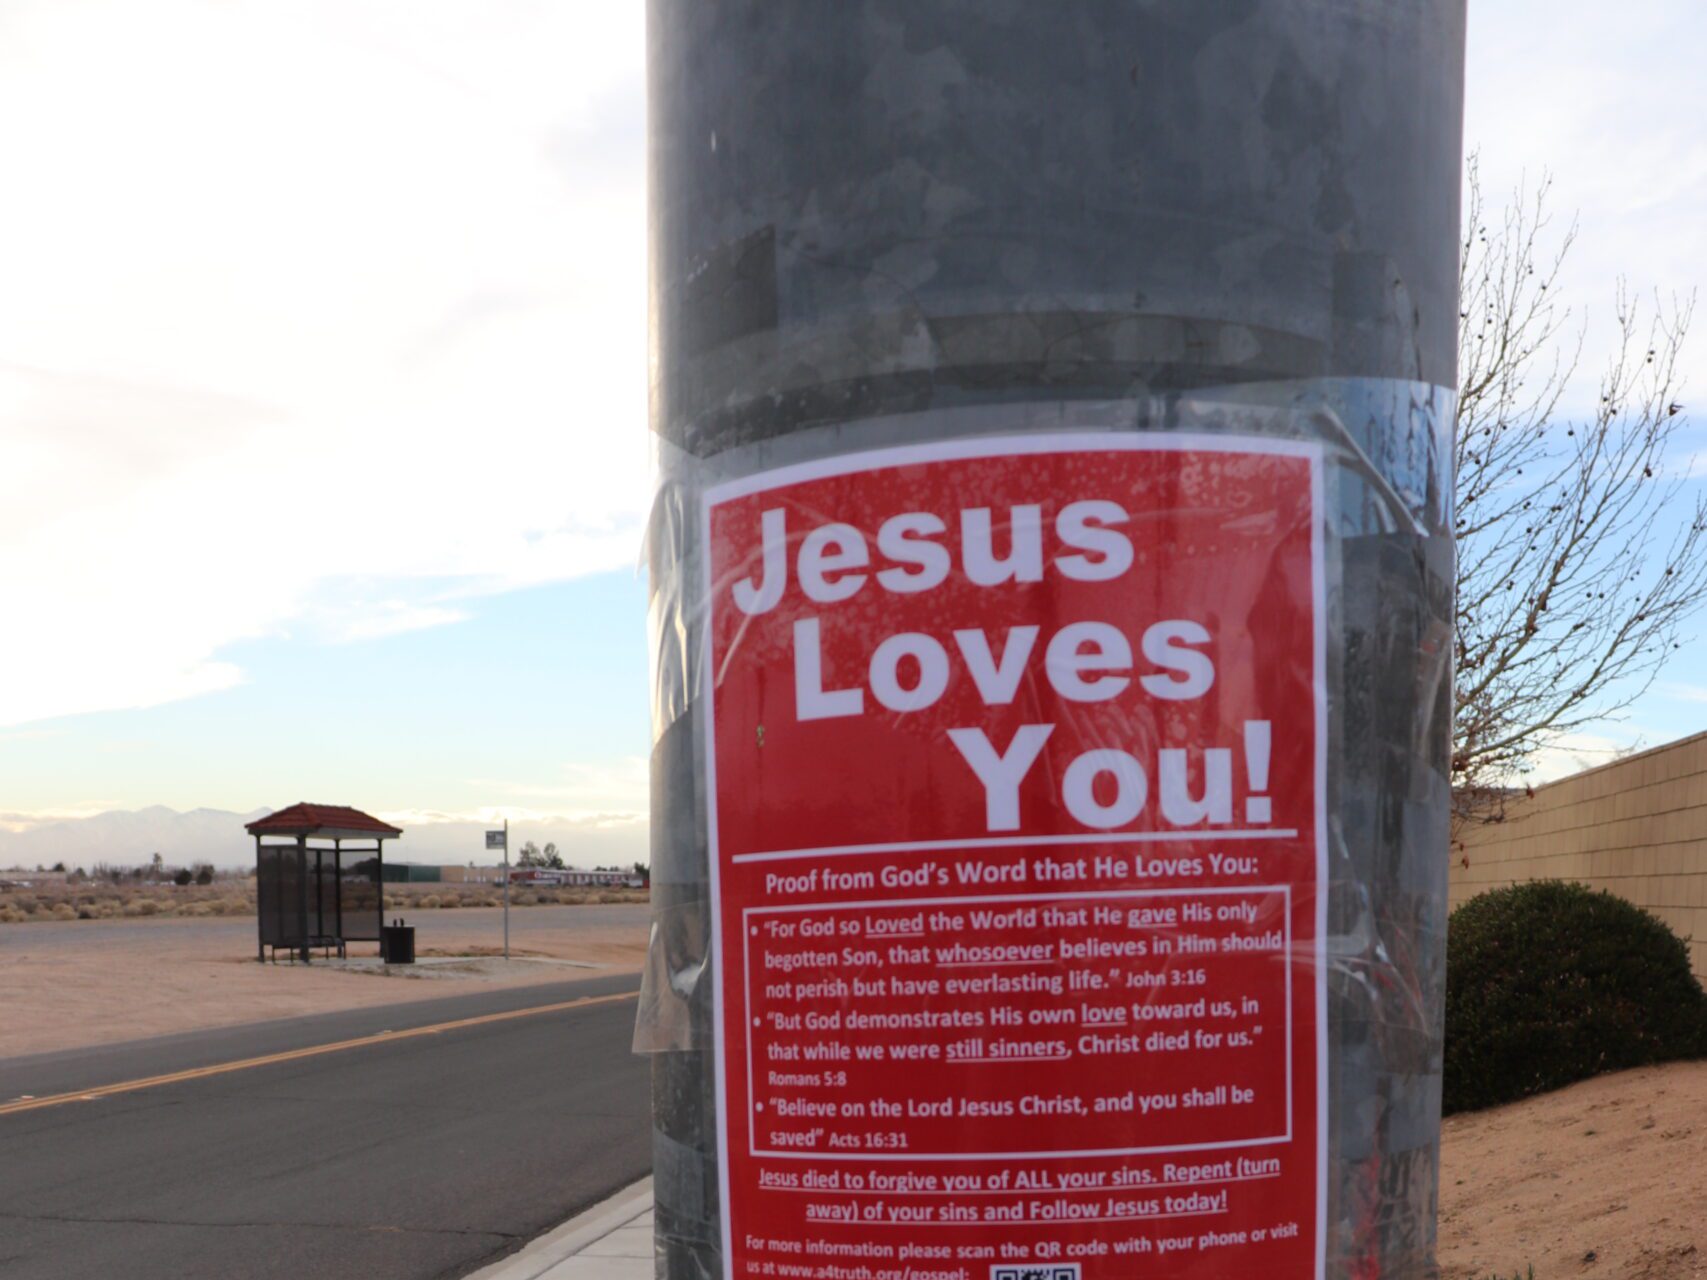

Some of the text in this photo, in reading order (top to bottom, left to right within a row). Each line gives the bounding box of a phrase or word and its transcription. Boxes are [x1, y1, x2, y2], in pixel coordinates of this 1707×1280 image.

[732, 500, 1135, 617] Jesus
[793, 618, 1215, 721] Loves
[947, 719, 1272, 832] You!
[766, 853, 1258, 894] Proof from God's Word that He Loves You:
[800, 917, 835, 936] God
[840, 920, 860, 935] so
[866, 913, 924, 933] Loved
[929, 912, 963, 931] the
[970, 909, 1036, 929] World
[1042, 907, 1087, 926] that
[1094, 907, 1122, 923] He
[1128, 907, 1176, 927] gave
[1182, 903, 1212, 922] His
[1217, 901, 1257, 923] only
[765, 931, 1282, 972] begotten Son, that whosoever believes in Him should
[766, 982, 792, 998] not
[796, 980, 847, 1001] perish
[853, 977, 885, 996] but
[892, 976, 939, 995] have
[946, 973, 1063, 995] everlasting
[1126, 971, 1166, 988] John
[1171, 969, 1206, 985] 3:16
[806, 1012, 840, 1029] God
[846, 1008, 983, 1028] demonstrates
[990, 1007, 1023, 1025] His
[1029, 1007, 1075, 1024] own
[1081, 1003, 1126, 1023] love
[1132, 999, 1205, 1020] toward
[1210, 1000, 1237, 1018] us,
[1242, 997, 1258, 1014] in
[768, 1042, 799, 1060] that
[803, 1041, 850, 1060] while
[856, 1043, 883, 1059] we
[890, 1043, 940, 1058] were
[946, 1039, 982, 1058] still
[989, 1039, 1072, 1058] sinners,
[1078, 1035, 1139, 1055] Christ
[1146, 1032, 1189, 1051] died
[1195, 1030, 1221, 1048] for
[769, 1072, 846, 1086] Romans 5:8
[841, 1101, 865, 1117] on
[870, 1100, 902, 1117] the
[908, 1098, 952, 1117] Lord
[958, 1099, 1013, 1116] Jesus
[1020, 1096, 1088, 1115] Christ,
[1094, 1093, 1133, 1112] and
[1139, 1094, 1176, 1114] you
[1182, 1086, 1226, 1107] shall
[1232, 1085, 1254, 1103] be
[829, 1132, 860, 1147] Acts
[865, 1132, 908, 1148] 16:31
[759, 1157, 1280, 1192] Jesus died to forgive you of ALL your sins. Repent (turn
[806, 1189, 1227, 1222] away) of your sins and Follow Jesus today!
[746, 1223, 1297, 1260] For more information please scan the QR code with your phone or visit
[747, 1261, 760, 1273] us
[762, 1261, 775, 1274] at
